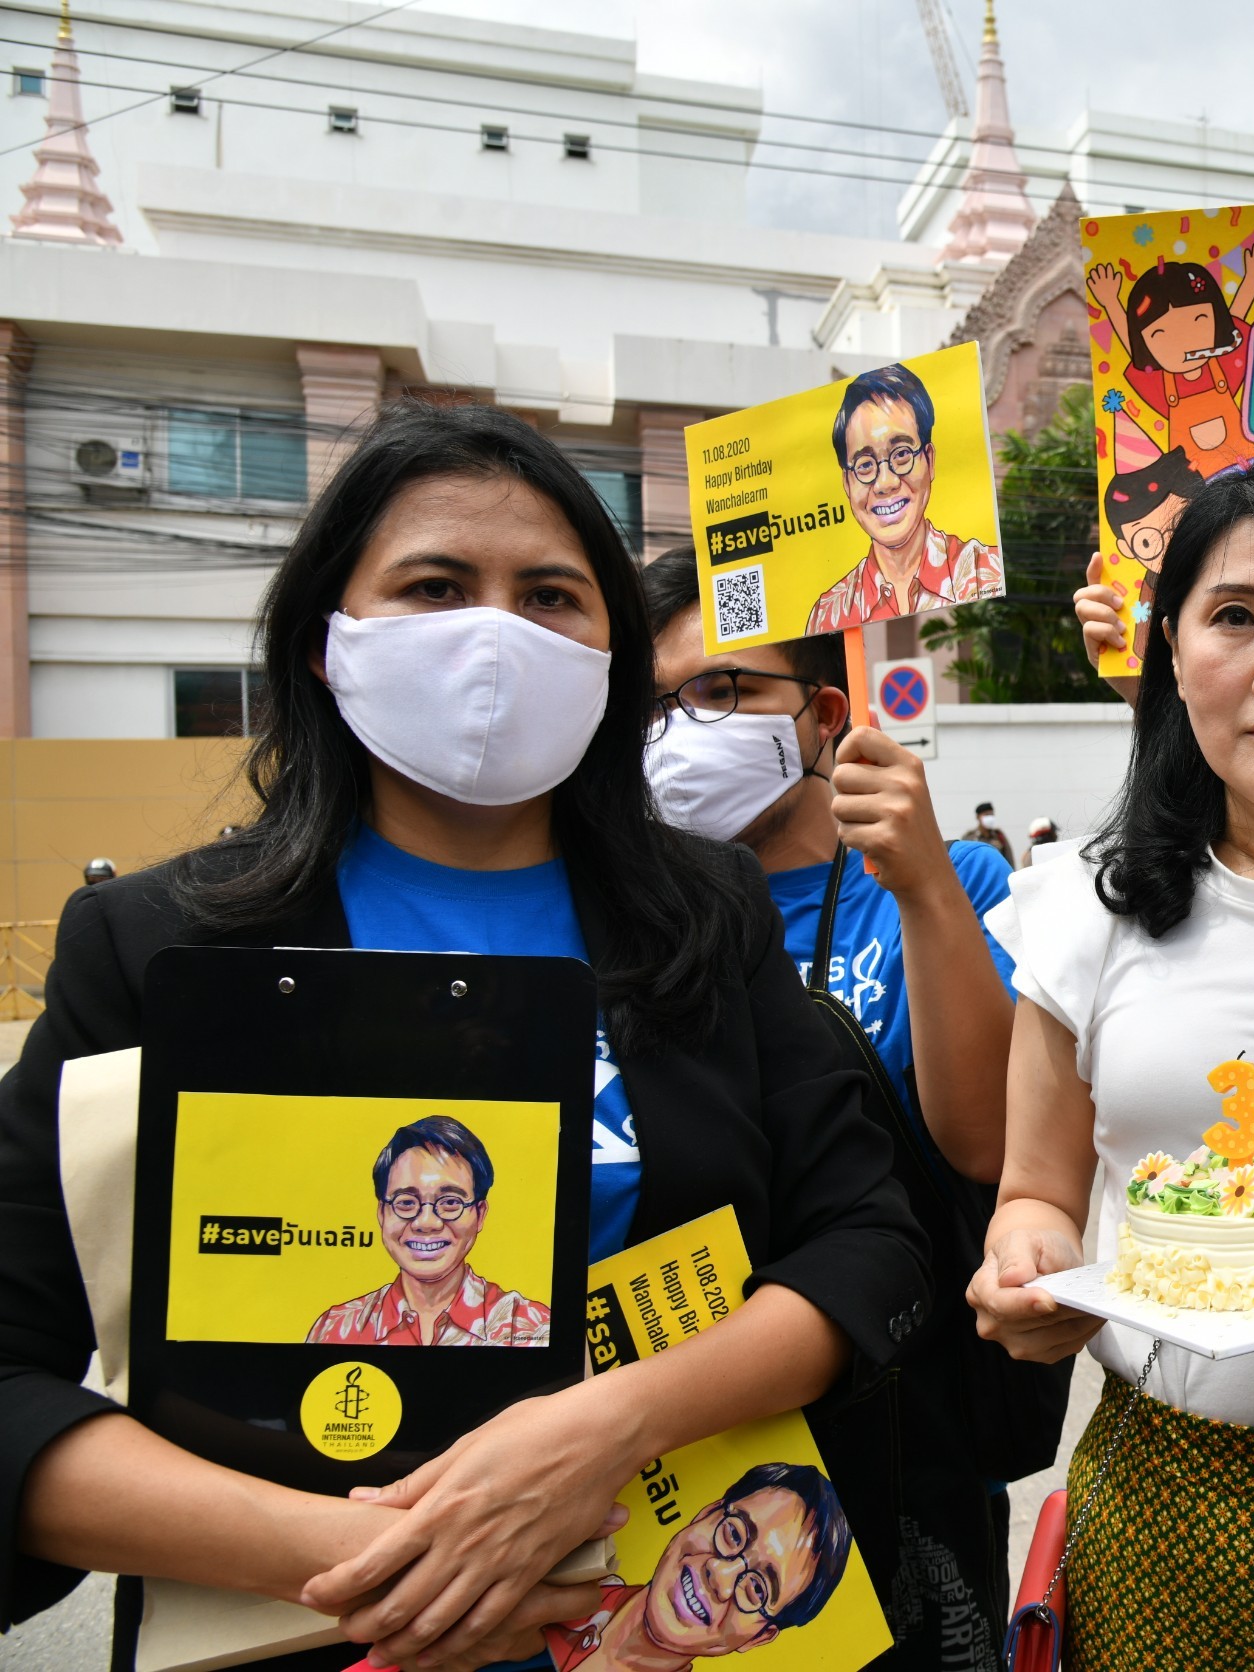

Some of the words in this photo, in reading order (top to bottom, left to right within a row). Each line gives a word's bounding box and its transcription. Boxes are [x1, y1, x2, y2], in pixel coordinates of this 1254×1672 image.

[702, 437, 751, 465] 11.08.2020
[705, 469, 733, 491] Happy
[734, 458, 773, 484] Birthday
[706, 486, 768, 515] Wanchalearm
[659, 1259, 690, 1312] Happy
[677, 1309, 701, 1339] Bir
[690, 1245, 730, 1324] 11.08.202
[324, 1423, 374, 1433] AMNESTY
